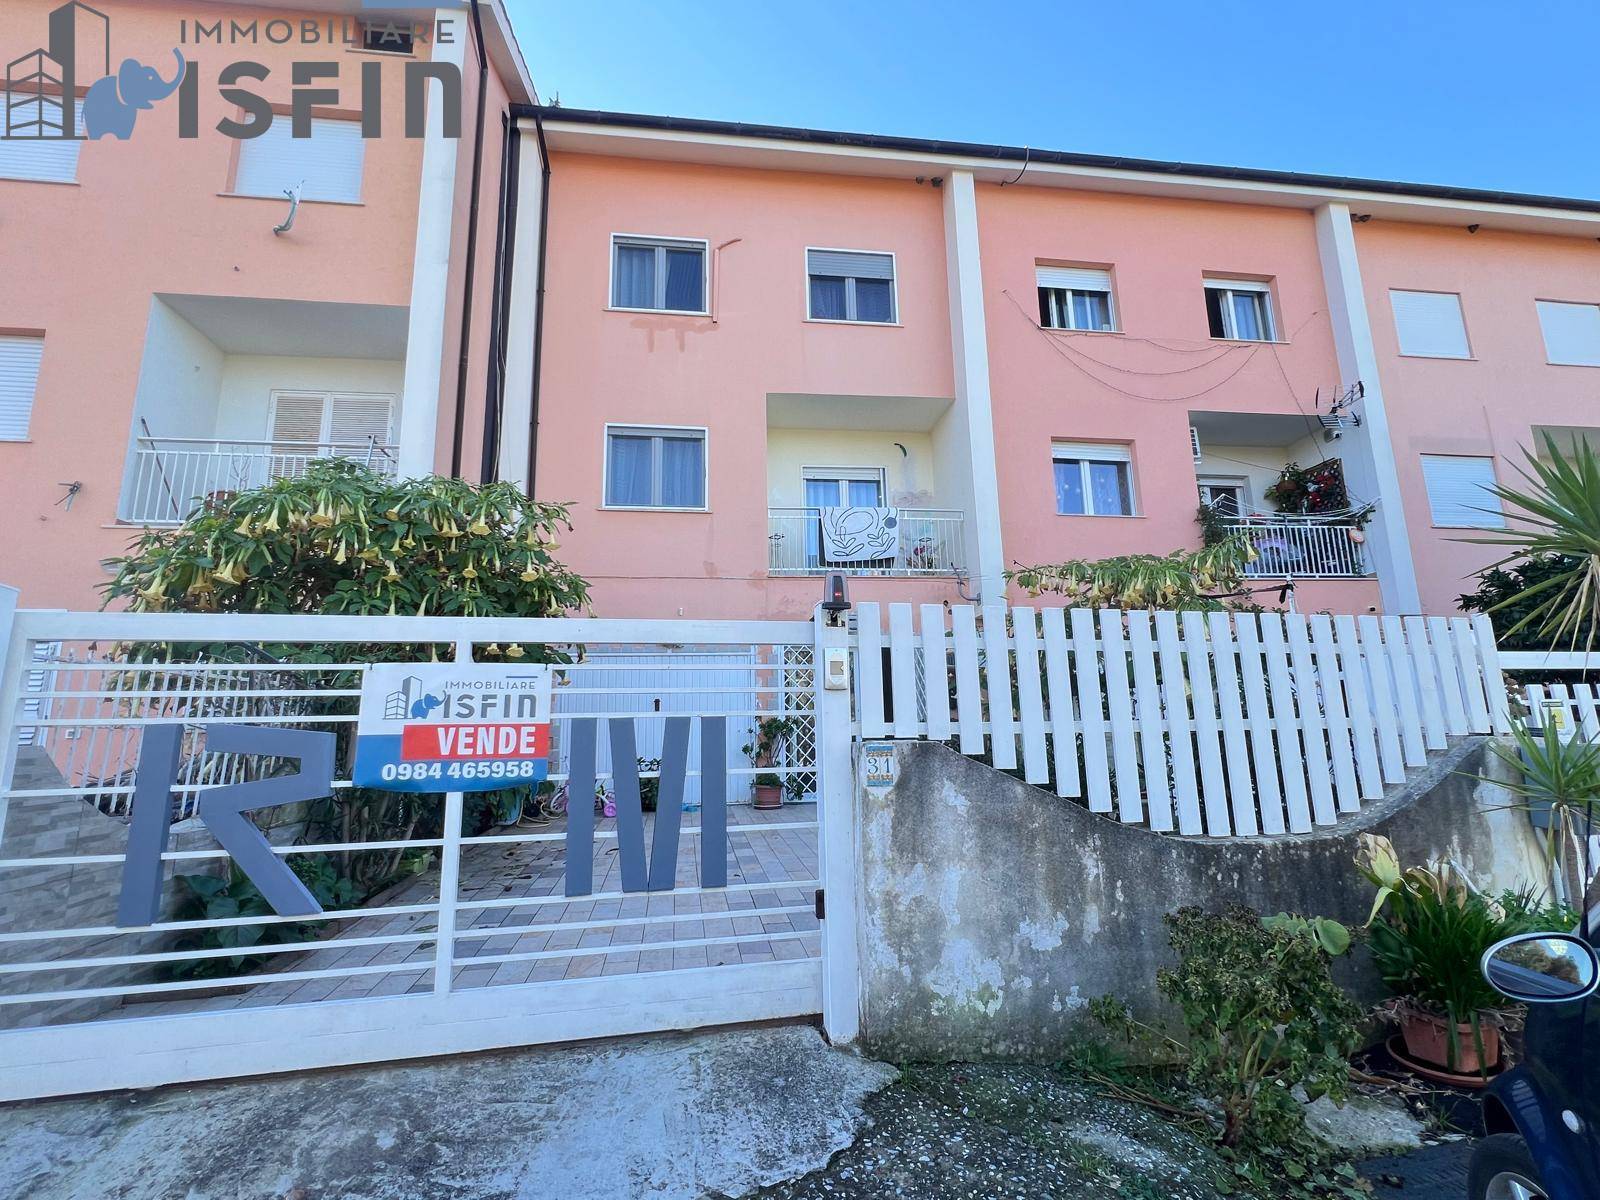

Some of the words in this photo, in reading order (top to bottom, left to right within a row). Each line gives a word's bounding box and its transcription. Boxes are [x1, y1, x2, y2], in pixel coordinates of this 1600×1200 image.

[444, 680, 536, 690] IMMOBILIARE
[437, 726, 536, 756] VENDE
[381, 762, 442, 781] 0984
[447, 761, 534, 779] 465958
[867, 757, 890, 774] 31
